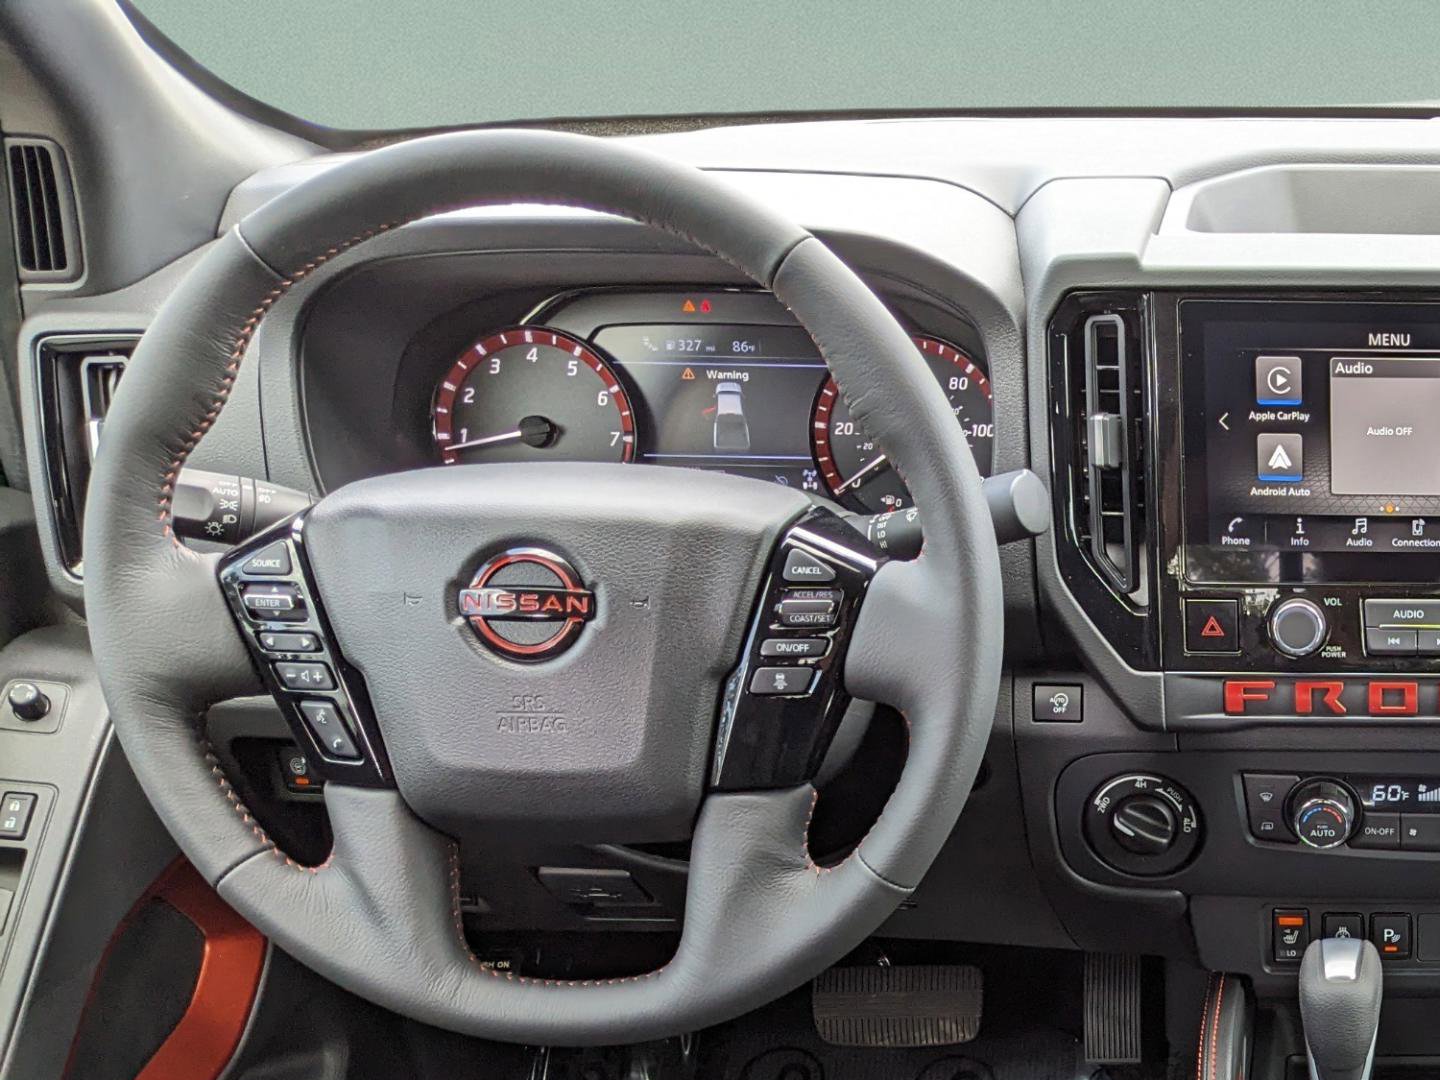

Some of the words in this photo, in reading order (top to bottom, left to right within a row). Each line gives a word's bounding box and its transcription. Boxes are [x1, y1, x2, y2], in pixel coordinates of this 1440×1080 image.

[1368, 333, 1411, 346] MENU
[678, 340, 702, 351] 327
[526, 347, 538, 362] 4
[489, 359, 501, 374] 3
[567, 361, 578, 376] 5
[1335, 362, 1373, 375] Audio
[706, 370, 750, 381] Warning
[949, 377, 968, 390] 80
[464, 388, 475, 403] 2
[597, 391, 608, 406] 6
[1249, 411, 1276, 422] Apple
[1277, 411, 1310, 423] CarPlay
[834, 422, 854, 436] 20
[1366, 426, 1394, 436] Audio
[1395, 426, 1413, 436] OFF
[460, 428, 468, 443] 1
[610, 432, 620, 446] 7
[212, 487, 239, 497] AUTO
[1250, 487, 1287, 497] Android
[1288, 487, 1310, 496] Auto
[1222, 536, 1250, 546] Phone
[1290, 537, 1310, 547] Info
[1346, 538, 1373, 547] Audio
[252, 558, 281, 569] SOURCE
[791, 565, 822, 575] CANCEL
[792, 591, 833, 600] ACCEL/RES
[255, 597, 281, 608] ENTER
[463, 593, 589, 613] NISSAN
[1324, 598, 1342, 606] VOL
[789, 614, 831, 623] COAST/SET
[1393, 610, 1424, 619] AUDIO
[776, 643, 810, 653] ON/OFF
[1321, 651, 1346, 659] POWER
[512, 695, 546, 711] SRS
[1053, 706, 1067, 714] OFF
[496, 716, 568, 733] AIRBAG
[1134, 781, 1147, 789] 4H
[1310, 829, 1336, 837] AUTO
[1364, 827, 1395, 836] ON-OFF
